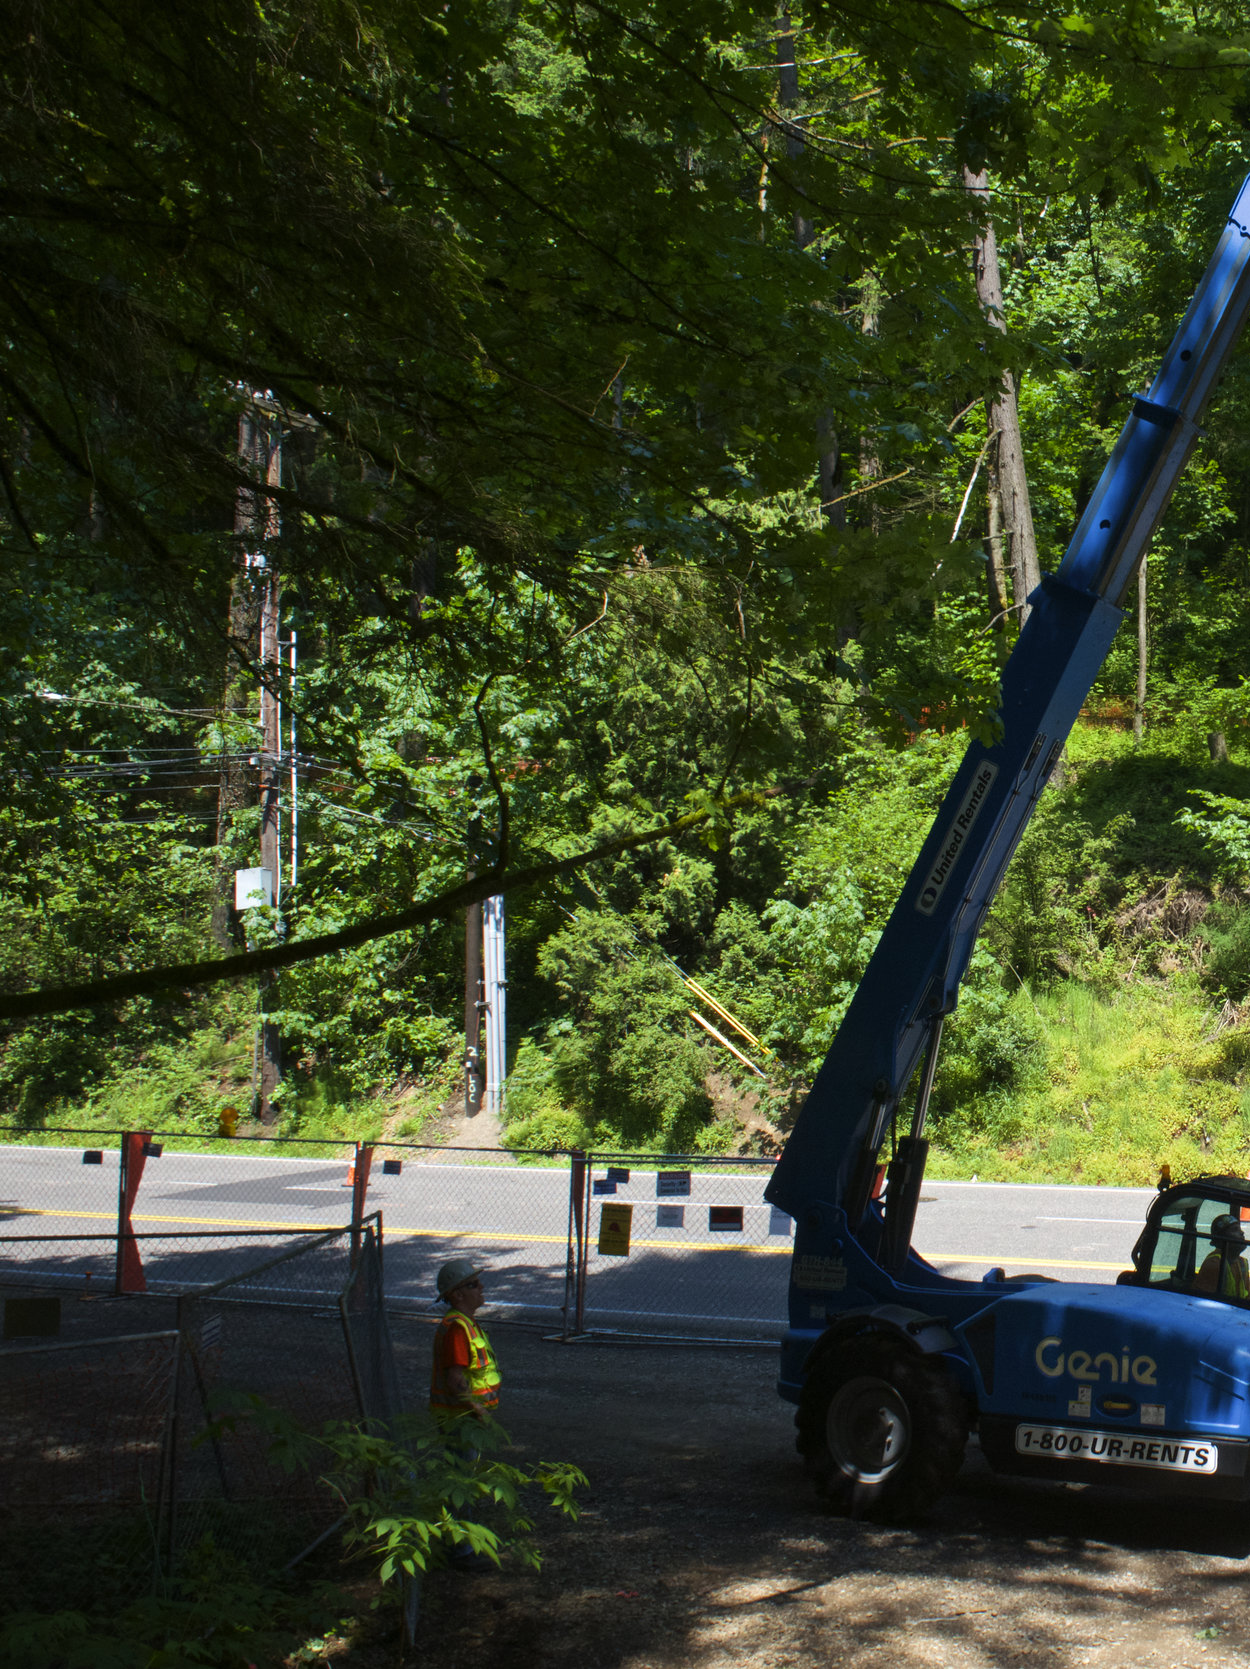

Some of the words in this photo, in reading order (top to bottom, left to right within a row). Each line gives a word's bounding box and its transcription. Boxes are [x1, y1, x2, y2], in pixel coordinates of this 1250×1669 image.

[931, 830, 963, 886] United
[957, 769, 992, 829] Rentals
[466, 1046, 479, 1056] 2
[1035, 1336, 1157, 1386] Genie
[1023, 1431, 1209, 1466] 1-800-UR-RENTS
